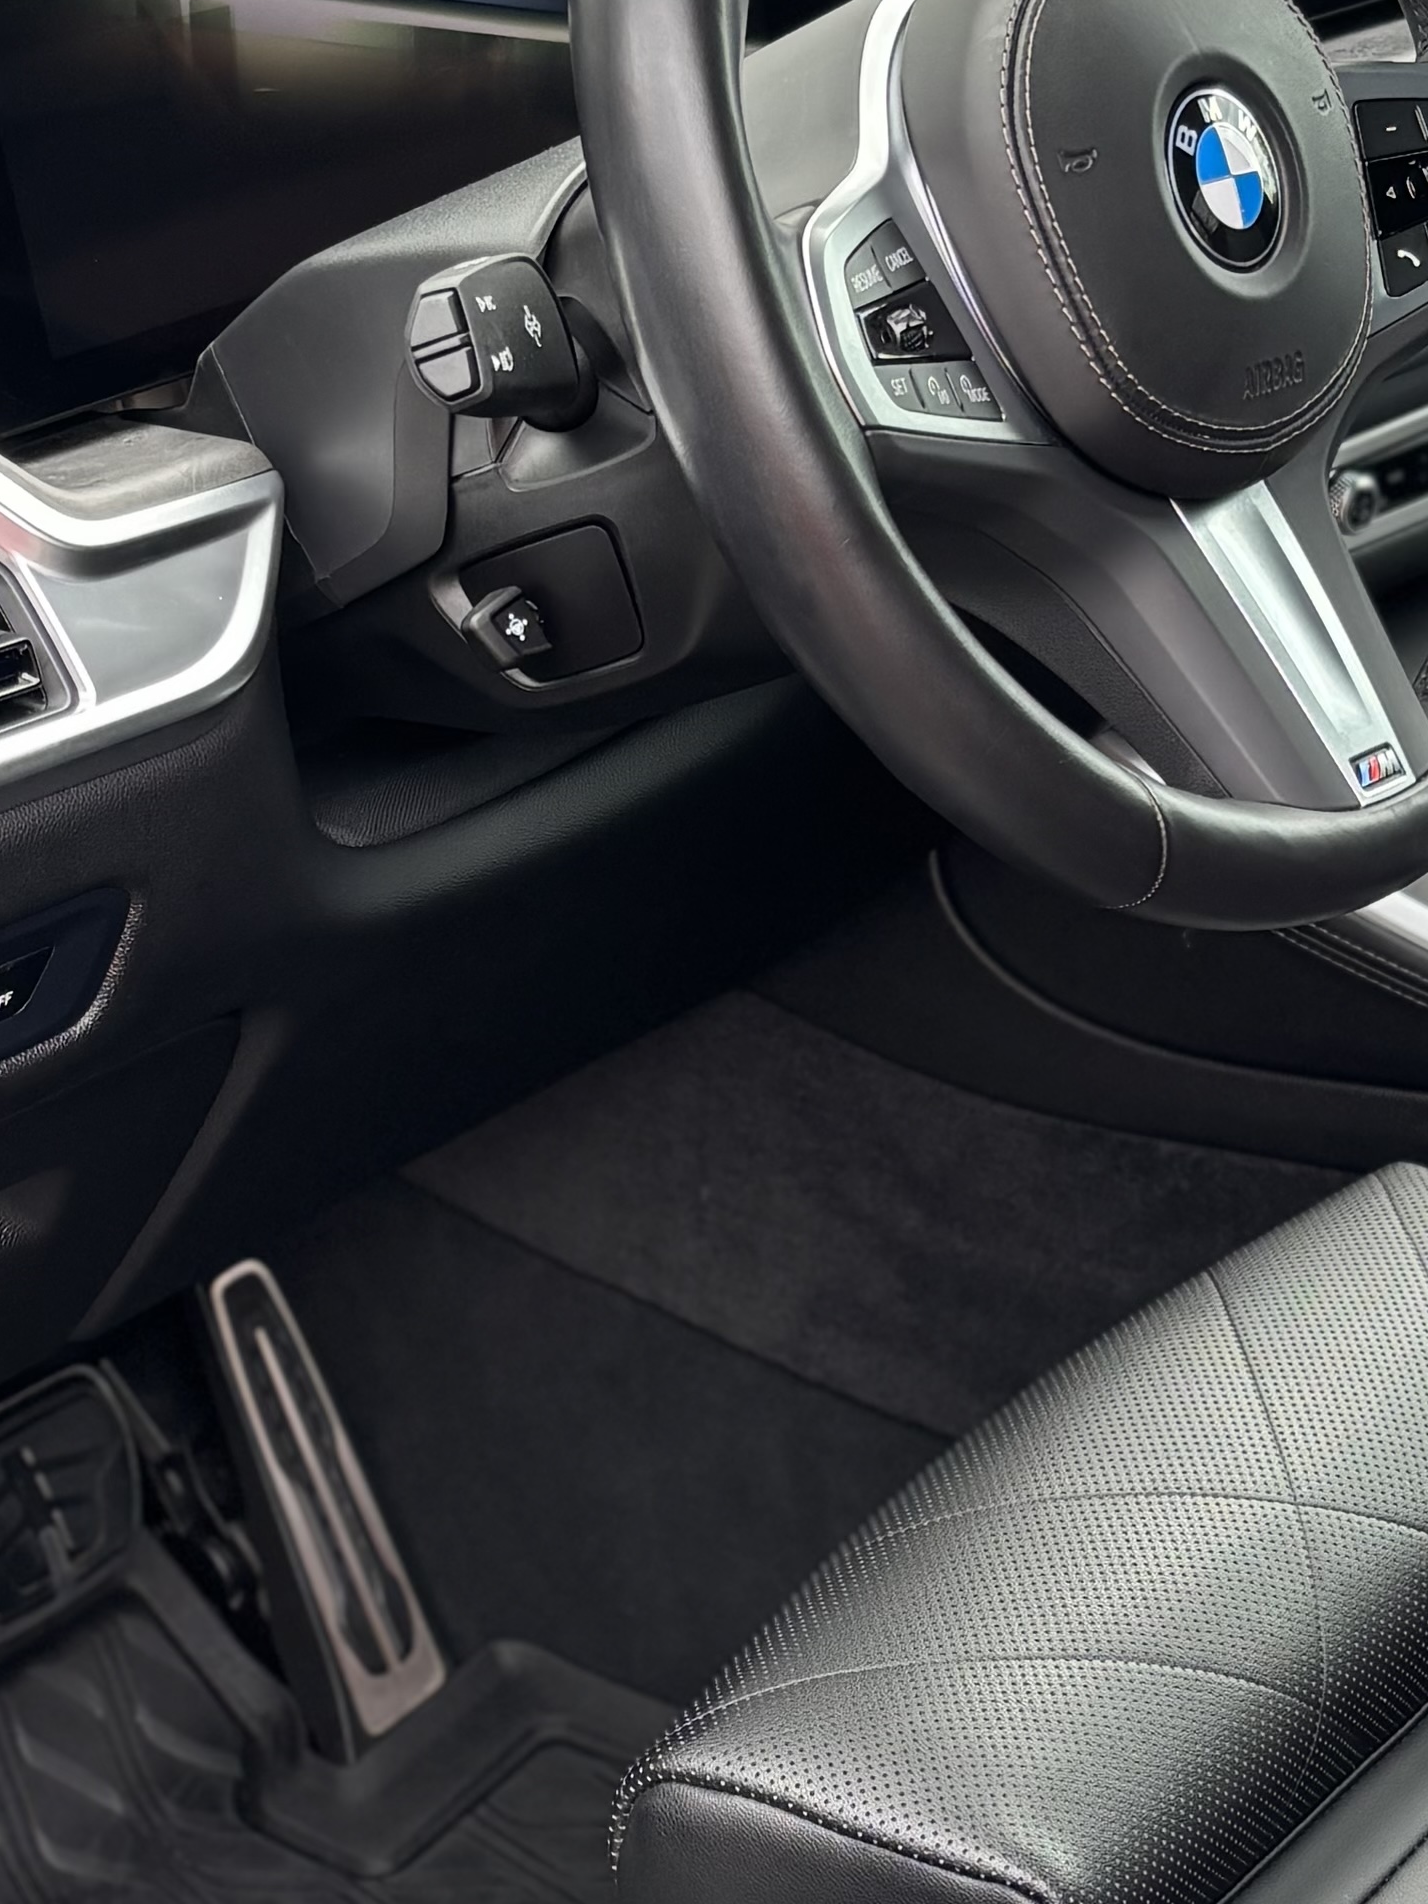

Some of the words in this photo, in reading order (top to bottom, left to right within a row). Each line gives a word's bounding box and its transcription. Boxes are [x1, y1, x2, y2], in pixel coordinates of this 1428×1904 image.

[1176, 96, 1258, 156] BMW
[884, 246, 914, 272] CANCEL
[851, 264, 884, 293] RESUME
[890, 377, 909, 397] SET
[1243, 350, 1304, 400] AIRBAG
